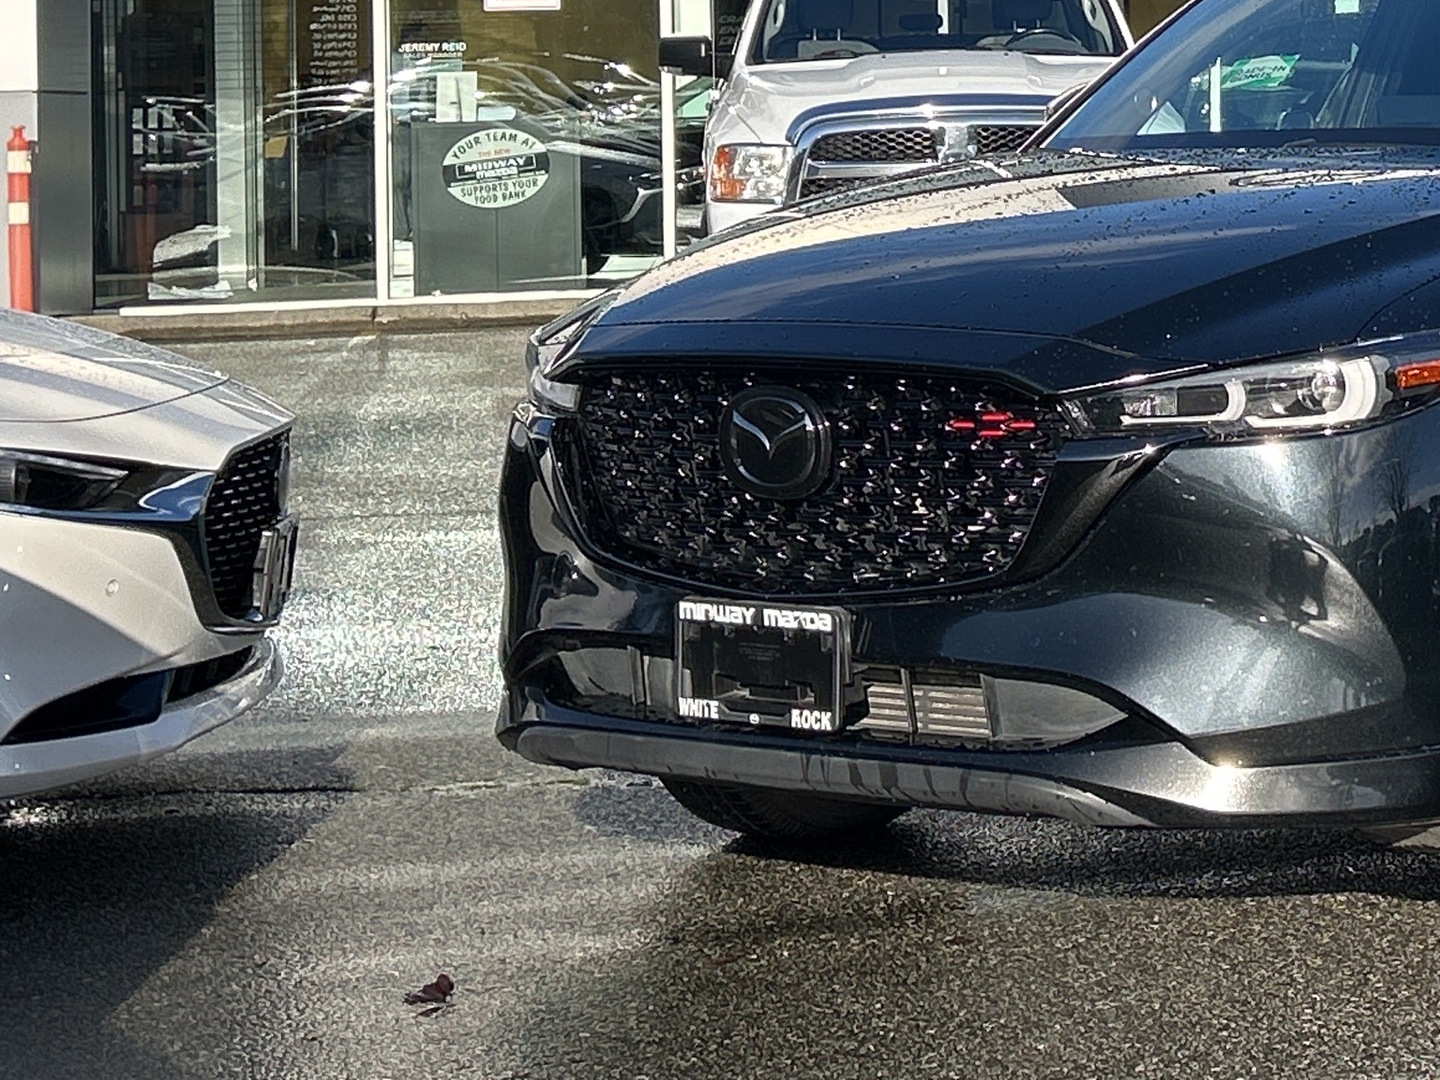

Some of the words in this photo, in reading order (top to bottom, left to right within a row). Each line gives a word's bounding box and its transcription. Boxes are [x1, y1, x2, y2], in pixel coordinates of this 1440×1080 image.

[398, 42, 440, 53] JEREMY
[441, 42, 467, 52] REID
[451, 136, 481, 160] YOUR
[485, 131, 518, 143] TEAM
[520, 137, 536, 150] AT
[464, 156, 526, 173] MIDWAY
[460, 182, 509, 198] SUPPORTS
[511, 178, 539, 192] YOUR
[475, 194, 498, 205] FOOD
[501, 190, 527, 202] BANK
[678, 697, 719, 719] WHITE
[791, 708, 832, 731] ROCK
